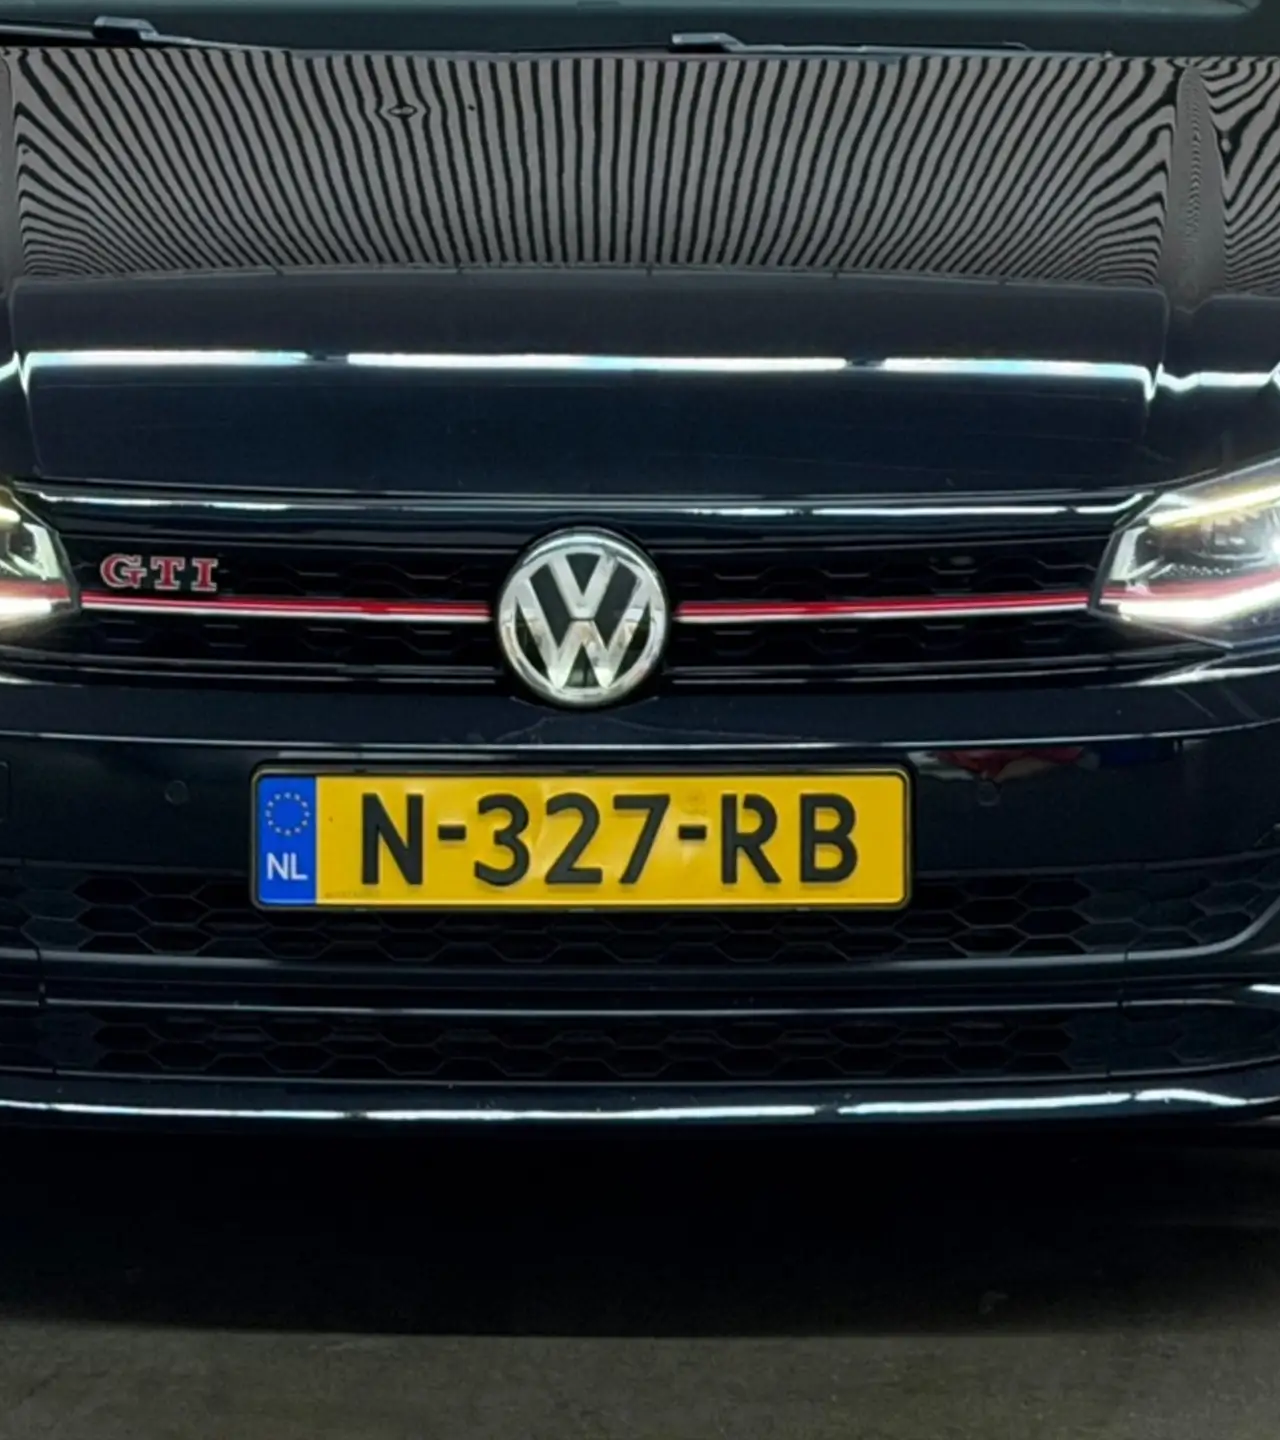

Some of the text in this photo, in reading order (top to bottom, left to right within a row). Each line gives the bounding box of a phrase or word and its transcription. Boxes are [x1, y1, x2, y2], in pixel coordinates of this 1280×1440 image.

[101, 553, 219, 593] GTI
[507, 540, 665, 698] VW
[266, 852, 308, 881] NL
[360, 792, 858, 886] N-327-RB
